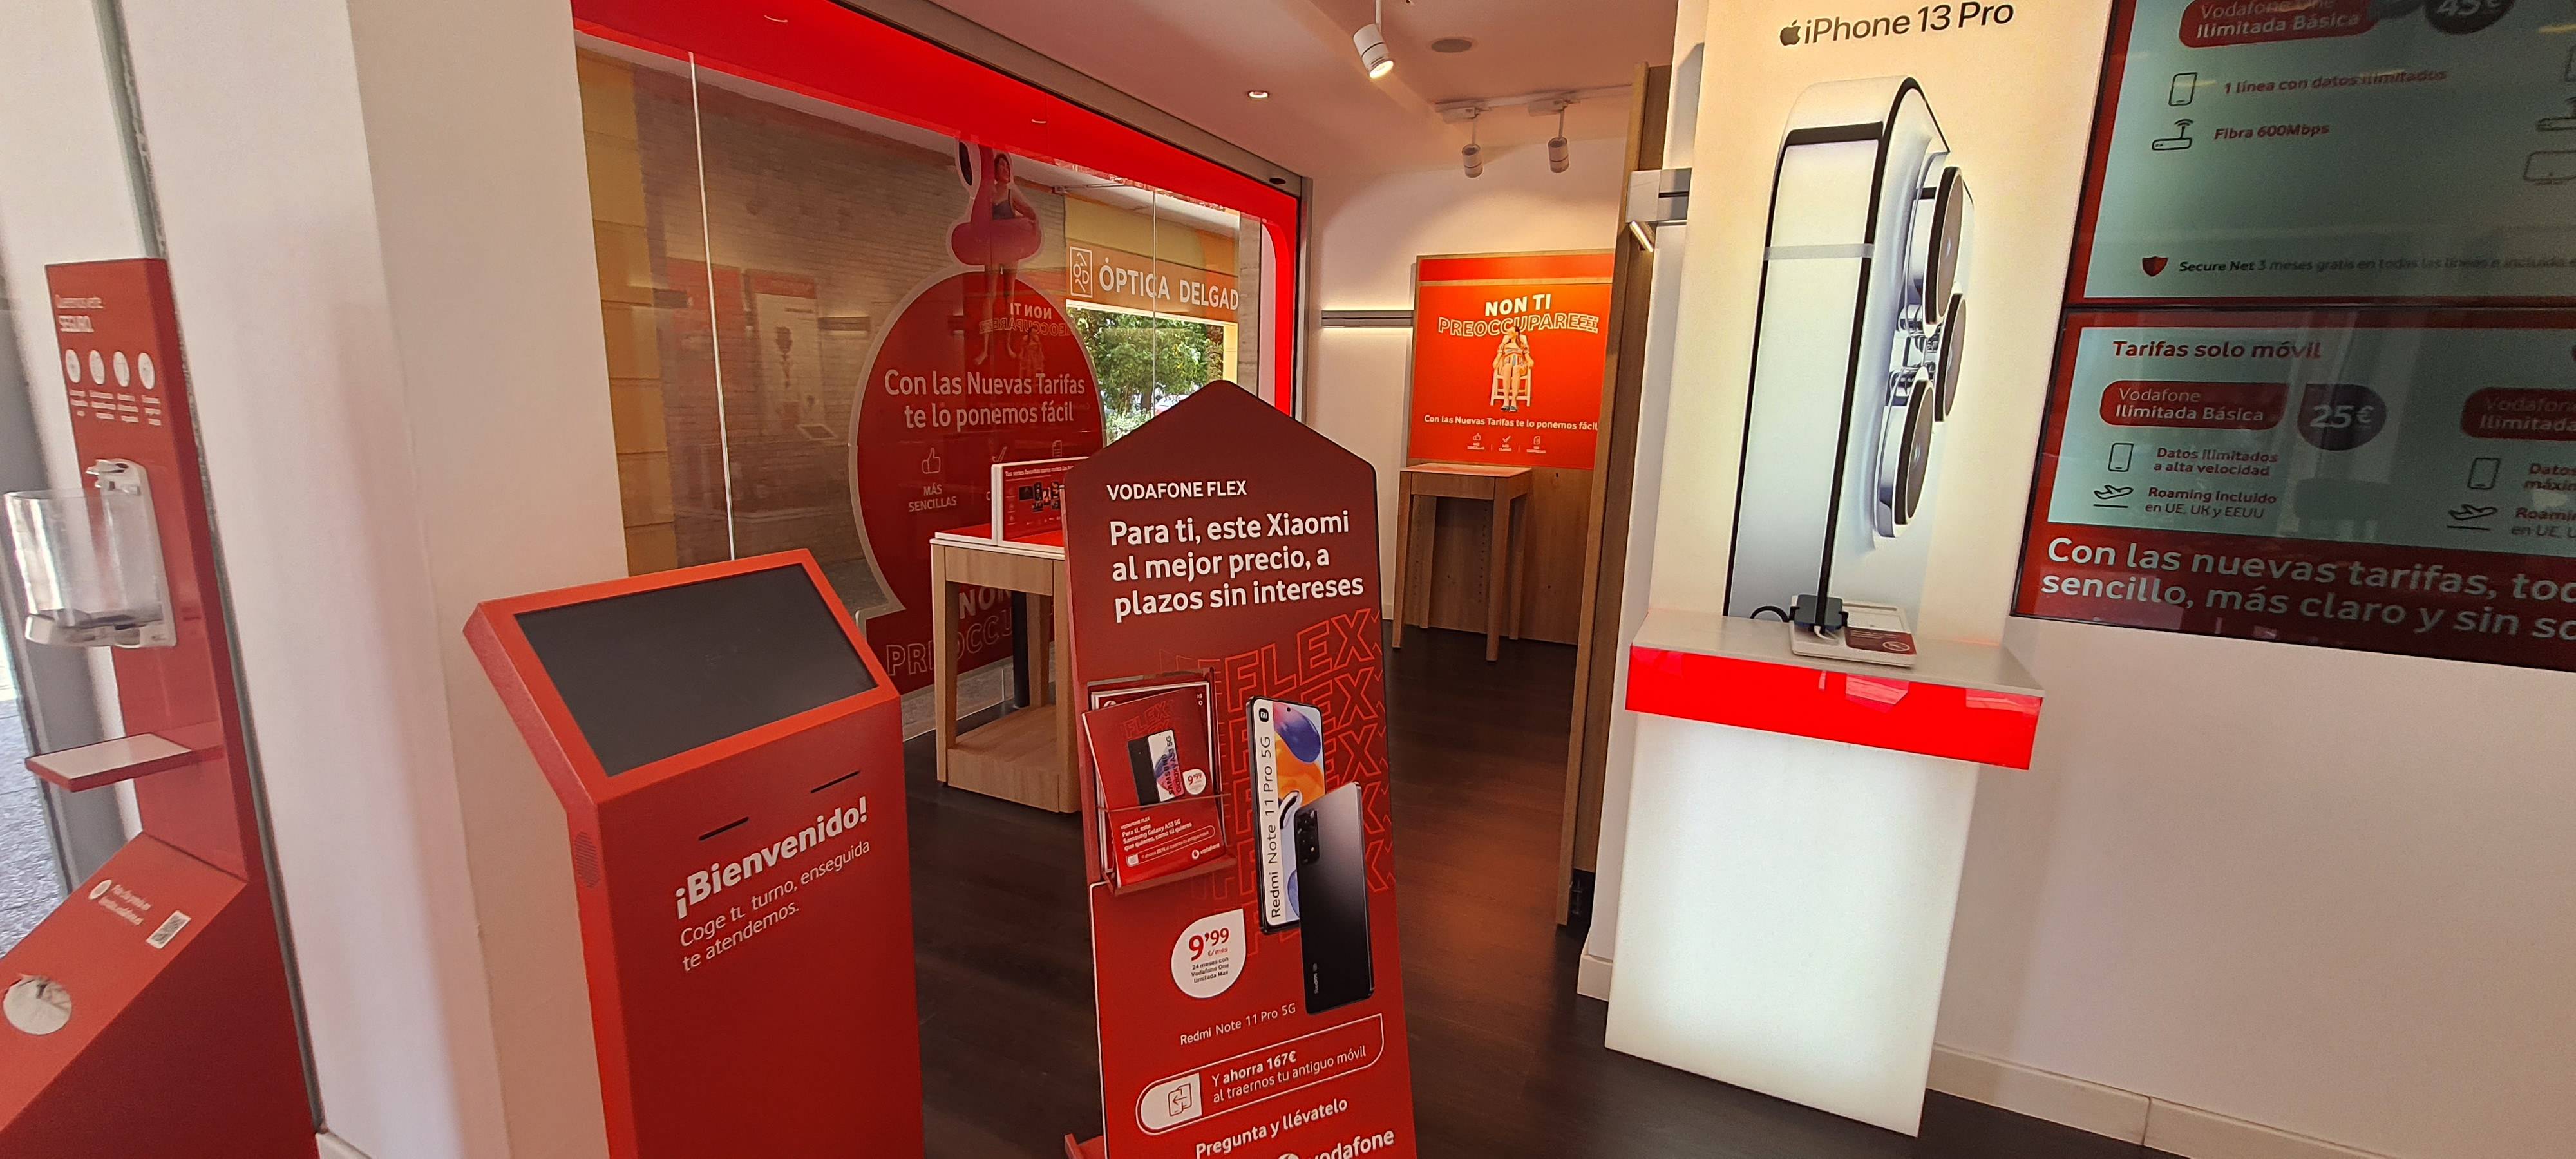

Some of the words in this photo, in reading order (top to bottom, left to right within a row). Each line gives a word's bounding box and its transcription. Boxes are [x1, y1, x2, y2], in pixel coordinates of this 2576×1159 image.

[1804, 15, 1911, 44] iPhone
[1918, 4, 1951, 32] 13
[1958, 1, 2014, 28] Pro
[2197, 18, 2286, 38] Ilimitada
[2293, 12, 2360, 30] Básica
[2225, 82, 2230, 94] 1
[2236, 80, 2275, 94] línea
[2279, 79, 2307, 91] con
[2312, 75, 2358, 89] datos
[2215, 128, 2253, 140] Fibra
[2257, 124, 2329, 138] 600Mbps
[2179, 261, 2226, 272] Secure
[2230, 260, 2254, 272] Net
[2257, 260, 2267, 271] 3
[2269, 260, 2313, 270] meses
[2358, 260, 2376, 269] en
[1484, 296, 1528, 317] NON
[1533, 294, 1551, 310] TI
[2113, 340, 2188, 358] Tarifas
[2194, 341, 2245, 358] solo
[2251, 342, 2321, 358] móvil
[884, 369, 927, 395] Con
[933, 370, 962, 395] las
[967, 372, 1032, 395] Nuevas
[1035, 373, 1085, 395] Tarifas
[2119, 387, 2201, 402] Vodafone
[904, 405, 926, 428] te
[932, 402, 951, 428] lo
[956, 406, 1038, 432] ponemos
[1041, 400, 1074, 423] fácil
[1425, 414, 1439, 423] Con
[1455, 416, 1485, 425] Nuevas
[1487, 417, 1513, 427] Tarifas
[1516, 419, 1524, 427] te
[1537, 421, 1577, 430] ponemos
[1578, 420, 1598, 430] fácil
[2116, 404, 2197, 420] Ilimitada
[2202, 406, 2264, 422] Básica
[2310, 404, 2374, 429] 25€
[2157, 448, 2199, 459] Datos
[2154, 463, 2161, 471] a
[2166, 462, 2193, 472] alta
[2197, 463, 2270, 476] velocidad
[923, 482, 943, 496] MÁS
[1106, 481, 1203, 500] VODAFONE
[1208, 480, 1247, 496] FLEX
[2148, 487, 2211, 503] Roaming
[2215, 491, 2277, 504] incluido
[909, 496, 957, 512] SENCILLAS
[2191, 505, 2211, 516] UK
[2212, 507, 2222, 518] y
[2225, 507, 2265, 519] EEUU
[1110, 520, 1170, 546] Para
[1175, 517, 1201, 545] ti,
[1208, 516, 1261, 541] este
[1266, 509, 1349, 538] Xiaomi
[1112, 555, 1138, 581] al
[1145, 551, 1223, 583] mejor
[1229, 545, 1311, 579] precio,
[1316, 547, 1329, 567] a
[2047, 537, 2116, 566] Con
[2127, 543, 2182, 572] las
[2190, 552, 2338, 584] nuevas
[2349, 561, 2497, 599] tarifas,
[1115, 590, 1203, 624] plazos
[1209, 583, 1247, 608] sin
[1253, 577, 1363, 605] intereses
[2041, 574, 2194, 609] sencillo,
[2206, 585, 2292, 614] más
[2299, 592, 2406, 624] claro
[2413, 607, 2445, 634] y
[2452, 606, 2519, 636] sin
[1224, 608, 1375, 713] FLEX
[1261, 737, 1273, 759] 5G
[1264, 766, 1273, 793] Pro
[1264, 799, 1274, 816] 11
[676, 796, 867, 919] ¡Bienvenido!
[1267, 825, 1278, 864] Note
[680, 912, 726, 947] Coge
[751, 878, 798, 910] turno,
[800, 839, 870, 885] enseguida
[1269, 871, 1280, 918] Redmi
[683, 952, 701, 972] te
[706, 900, 800, 960] atendemos.
[1191, 966, 1217, 977] Vodafone
[1180, 1027, 1211, 1045] Redmi
[1215, 1021, 1242, 1035] Note
[1245, 1013, 1257, 1026] 11
[1261, 1010, 1278, 1022] Pro
[1282, 1003, 1296, 1016] 5G
[1212, 1073, 1220, 1087] Y
[1223, 1062, 1264, 1084] ahorra
[1267, 1050, 1296, 1070] 167€
[1213, 1089, 1224, 1103] al
[1227, 1076, 1275, 1098] traernos
[1277, 1071, 1289, 1082] tu
[1293, 1058, 1334, 1079] antiguo
[1337, 1045, 1366, 1064] móvil
[1196, 1126, 1267, 1159] Pregunta
[1271, 1121, 1280, 1138] y
[1283, 1098, 1348, 1131] llévatelo
